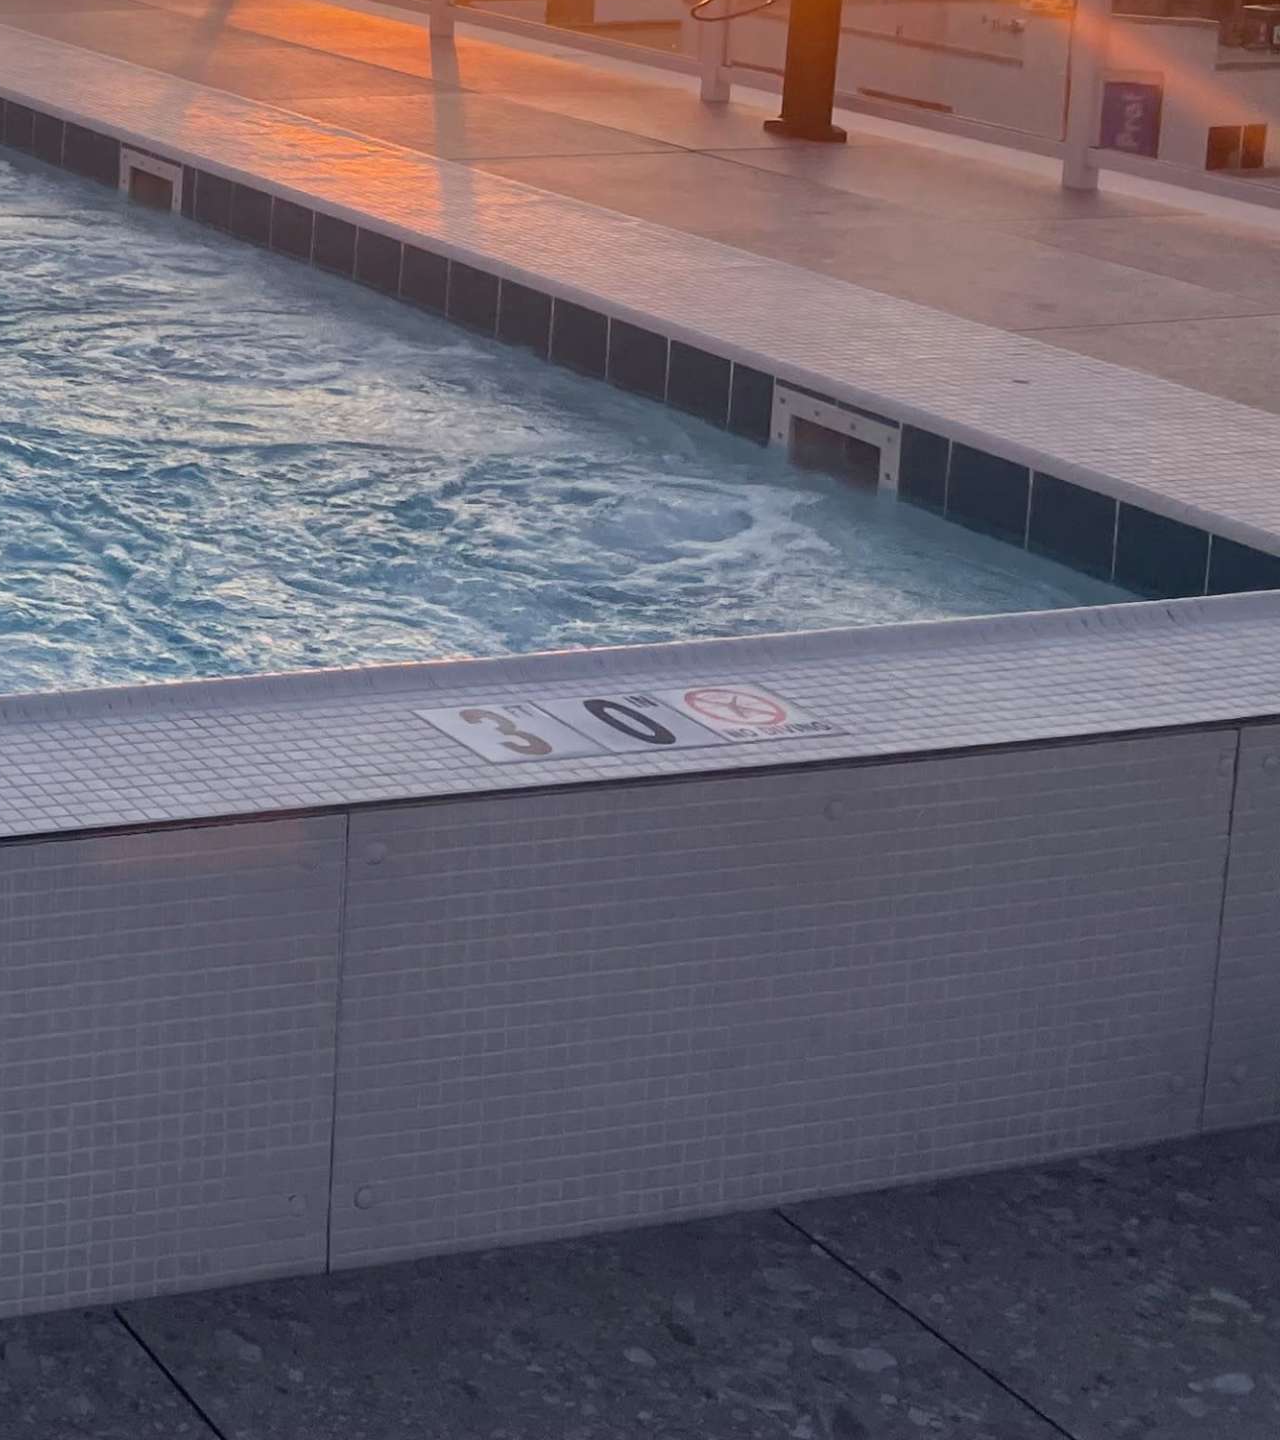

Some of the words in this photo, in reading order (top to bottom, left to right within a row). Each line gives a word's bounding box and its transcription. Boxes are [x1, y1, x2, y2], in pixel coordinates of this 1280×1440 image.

[458, 709, 554, 756] 3
[582, 698, 677, 745] 0
[757, 720, 833, 737] DIVING
